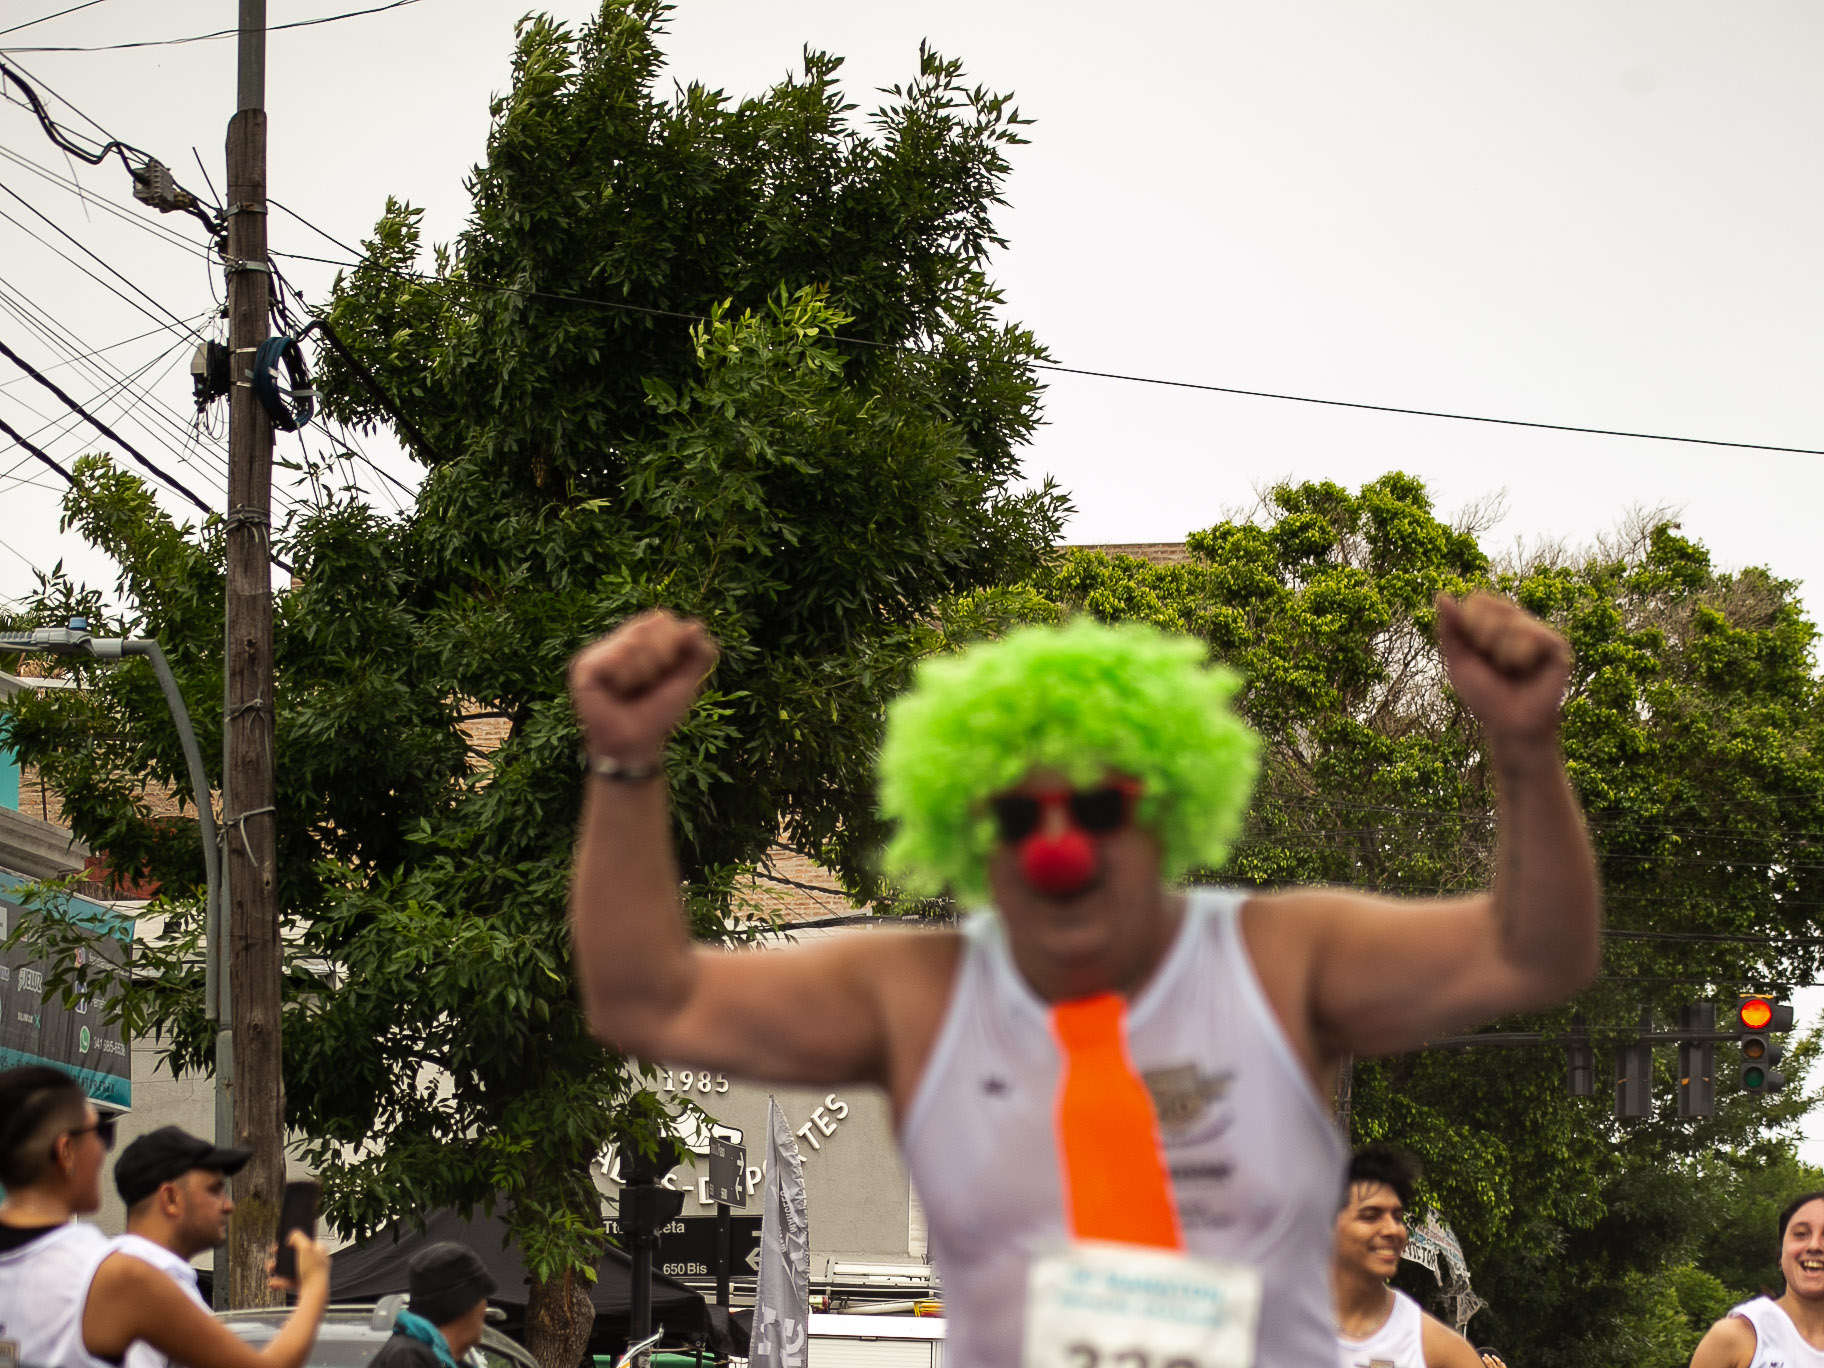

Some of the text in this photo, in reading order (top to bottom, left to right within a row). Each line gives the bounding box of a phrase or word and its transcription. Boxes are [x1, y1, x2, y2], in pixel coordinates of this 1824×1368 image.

[663, 1070, 729, 1093] 1985
[663, 1263, 708, 1275] 650 Bis
